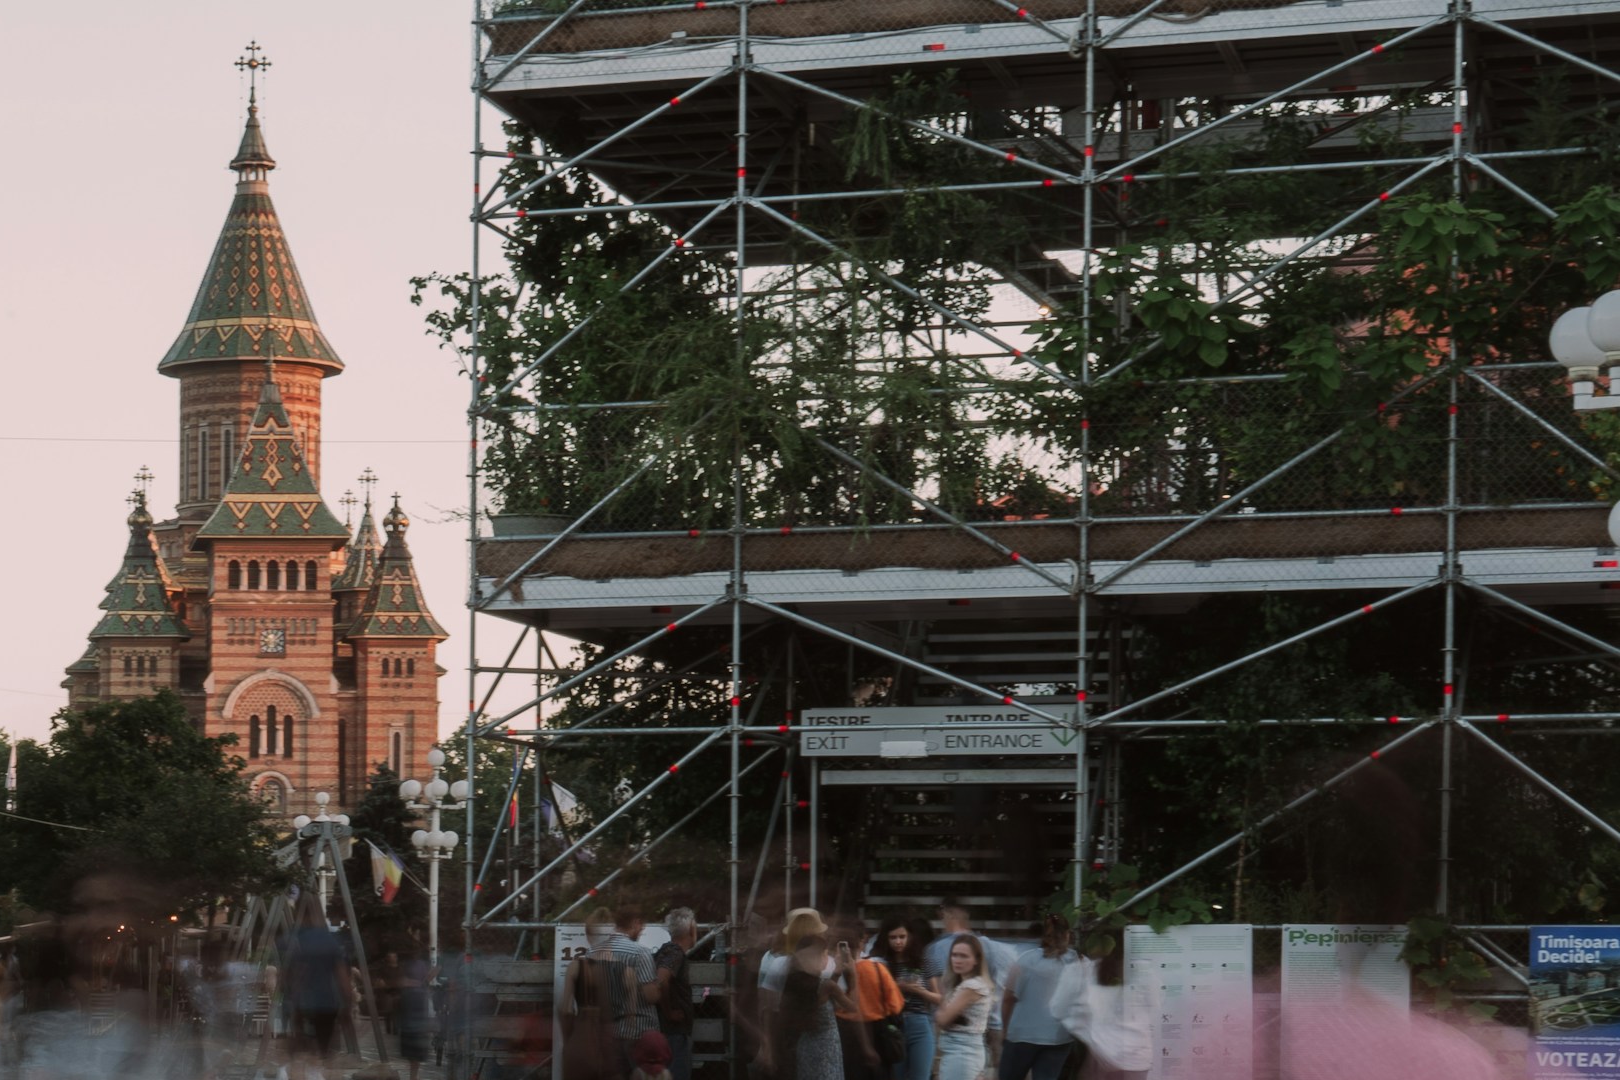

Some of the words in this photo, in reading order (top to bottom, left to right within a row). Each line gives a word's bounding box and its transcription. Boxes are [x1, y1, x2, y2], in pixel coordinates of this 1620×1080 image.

[806, 736, 849, 750] EXIT
[944, 733, 1043, 749] ENTRANCE
[1537, 935, 1620, 953] Timișoara
[1537, 949, 1601, 964] Decide!
[1536, 1051, 1620, 1068] VOTEAZ
